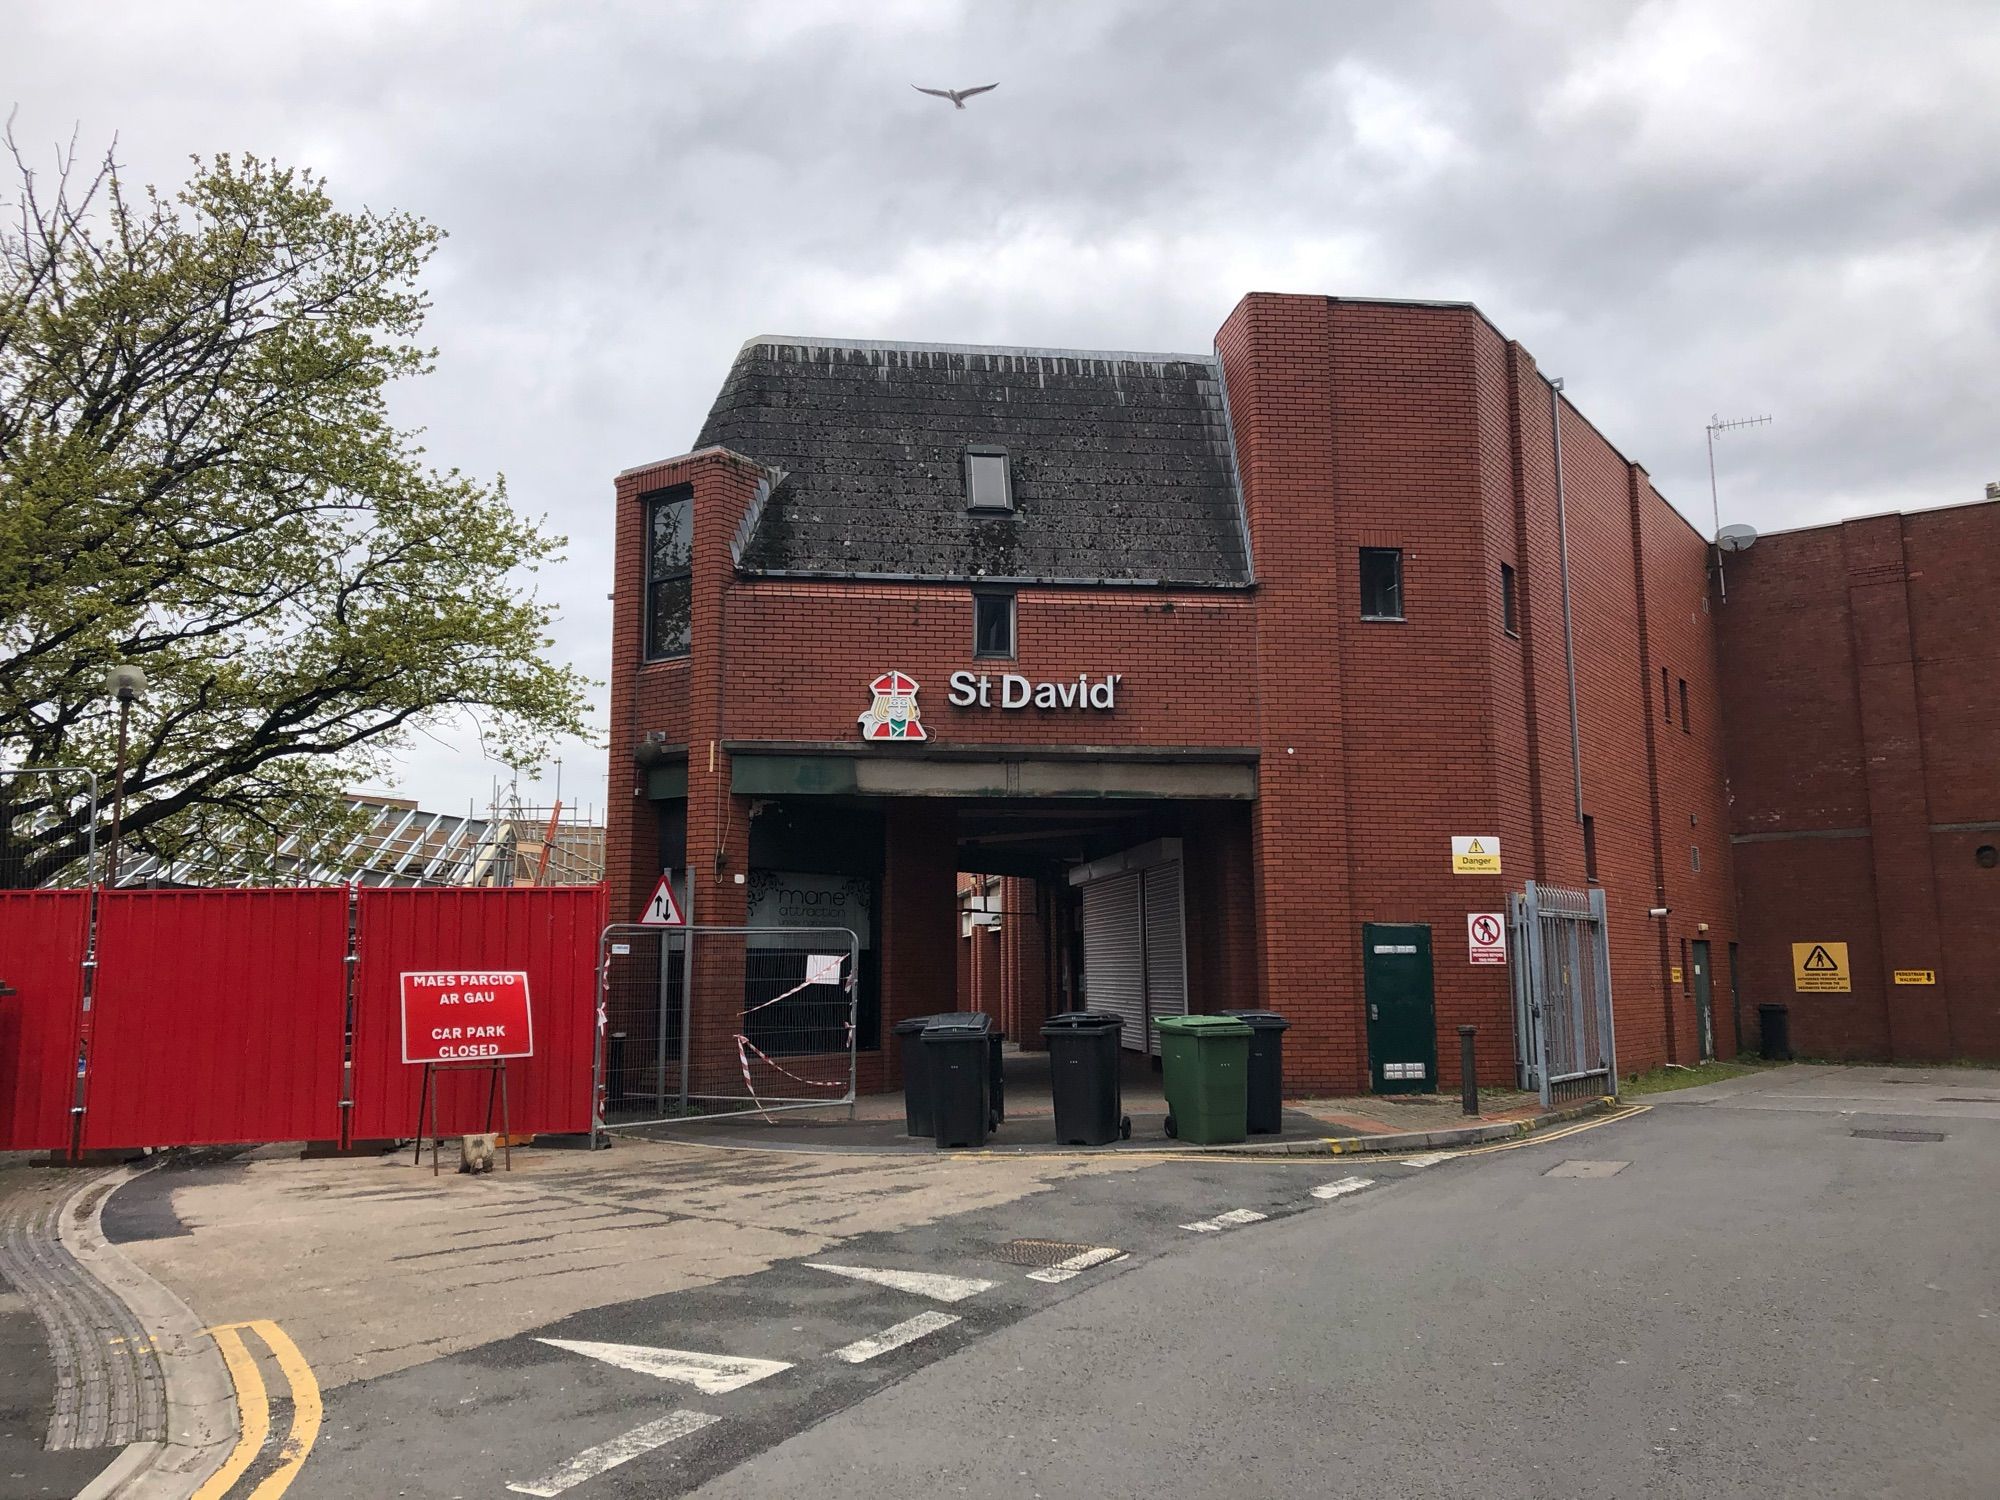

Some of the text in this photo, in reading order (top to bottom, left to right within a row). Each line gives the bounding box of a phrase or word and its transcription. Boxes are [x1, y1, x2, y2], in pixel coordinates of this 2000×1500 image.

[948, 671, 992, 708] St
[1462, 857, 1491, 866] Danger
[779, 889, 845, 906] mane
[779, 905, 846, 918] attraction
[413, 975, 515, 988] MAES PARCIO
[439, 991, 495, 1005] AR GAU
[431, 1025, 506, 1040] CAR PARK
[438, 1044, 499, 1058] CLOSED
